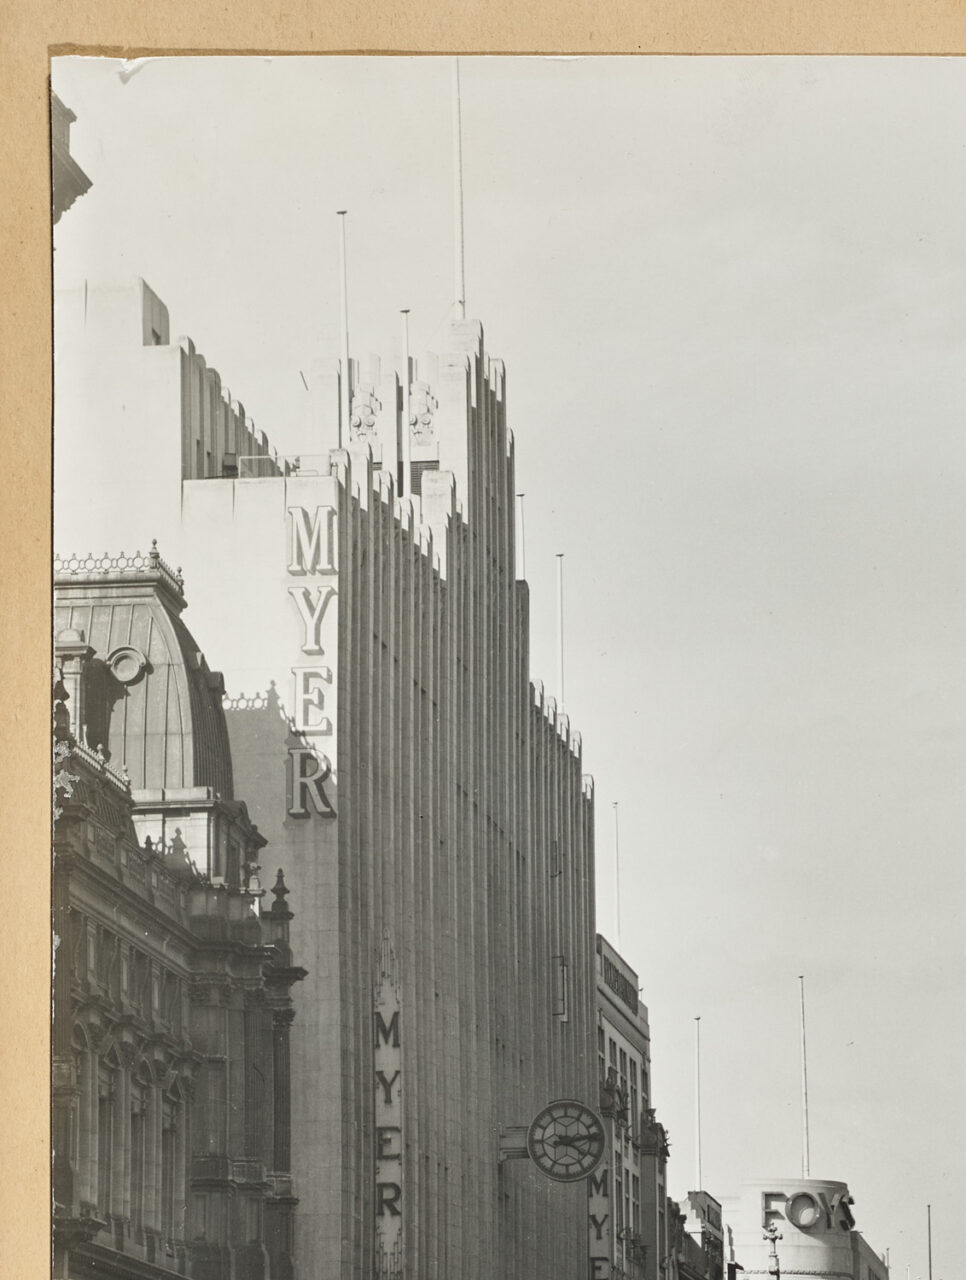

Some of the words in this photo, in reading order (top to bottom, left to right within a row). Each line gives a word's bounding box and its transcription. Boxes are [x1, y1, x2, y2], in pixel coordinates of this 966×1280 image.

[287, 505, 338, 819] MYER
[374, 1010, 401, 1217] MYER
[761, 1190, 856, 1232] FOYS
